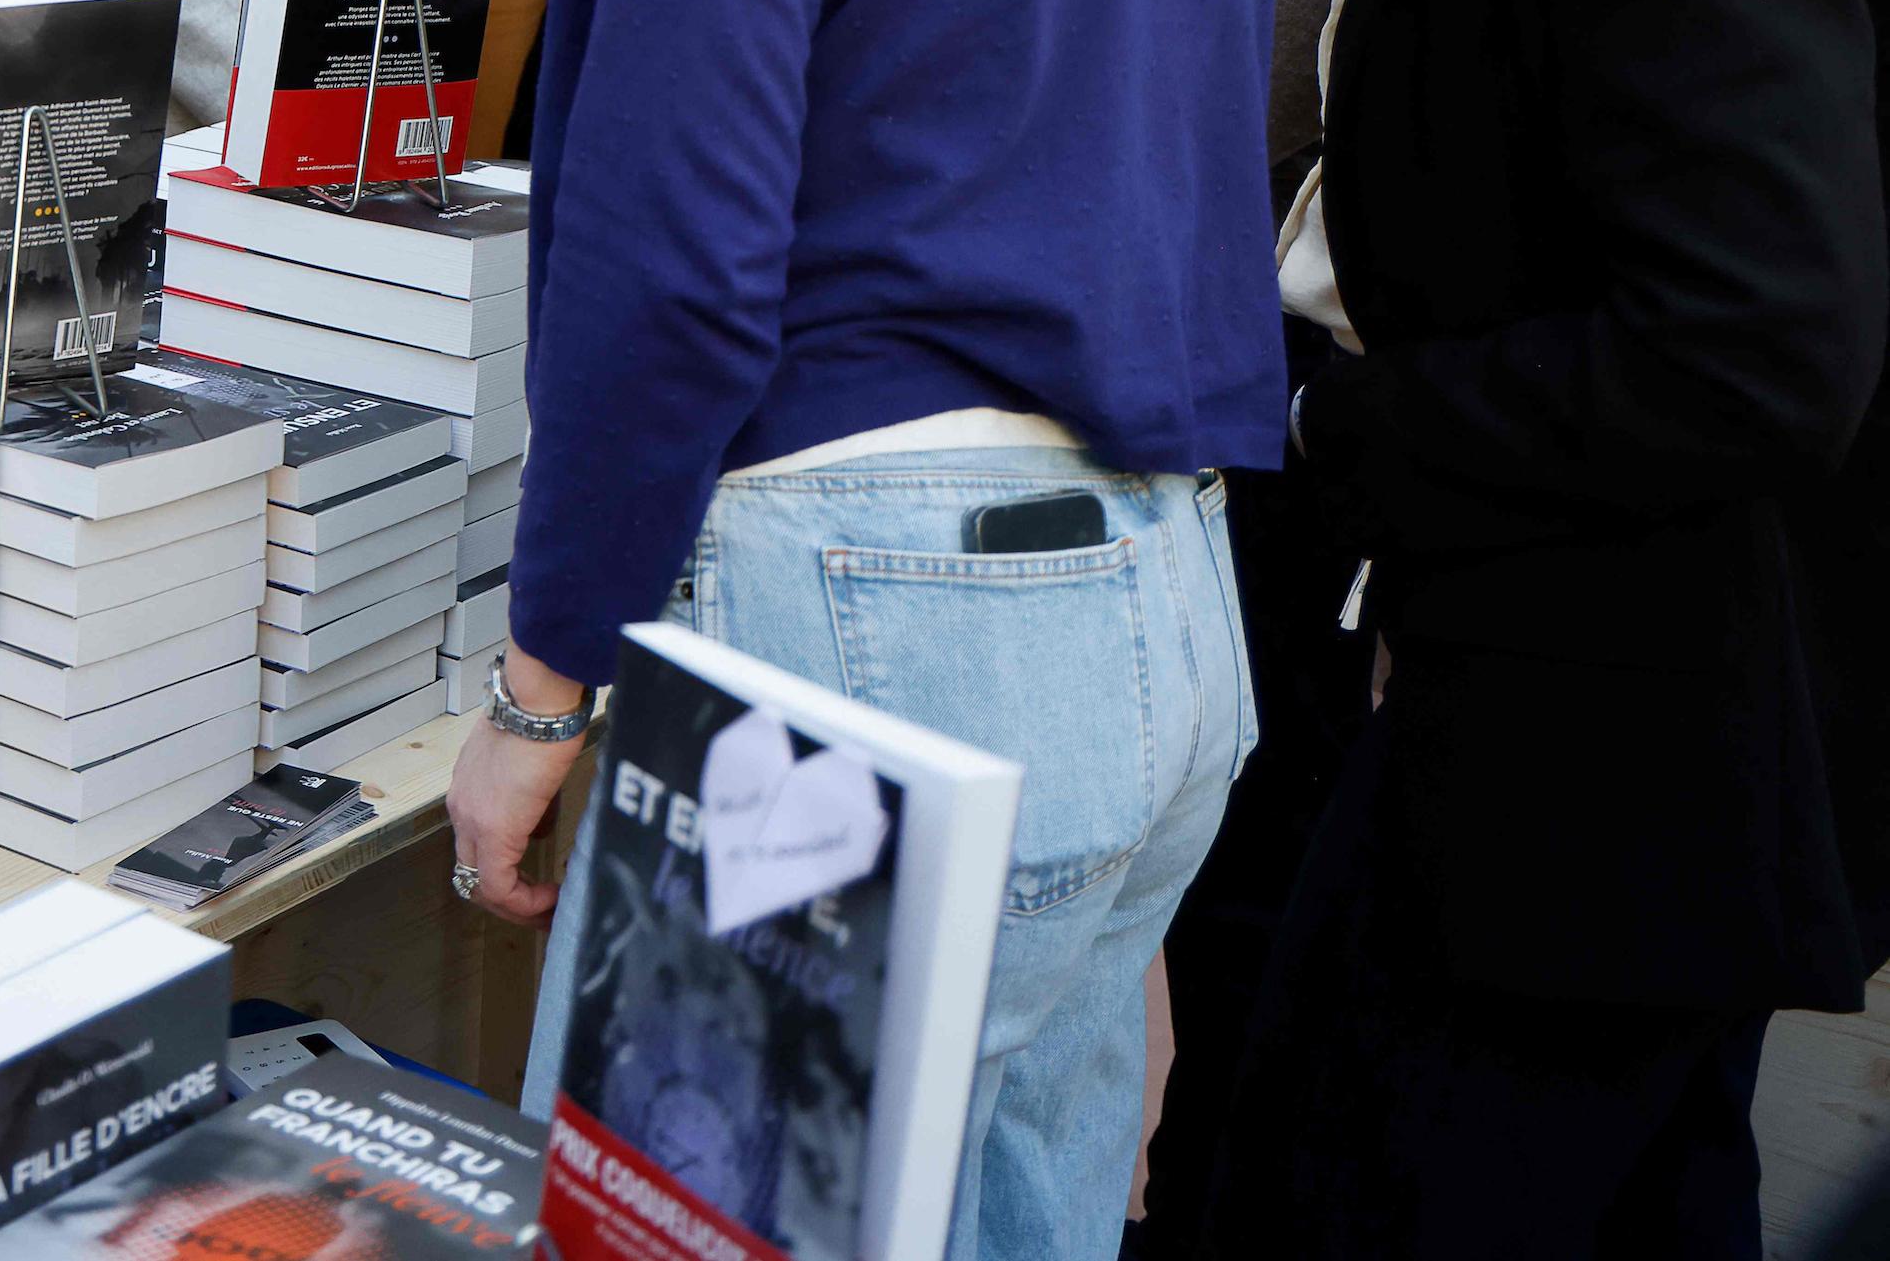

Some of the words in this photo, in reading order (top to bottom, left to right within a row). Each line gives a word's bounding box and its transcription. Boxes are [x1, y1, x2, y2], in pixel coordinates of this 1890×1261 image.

[343, 399, 382, 412] ET
[227, 805, 251, 815] QUE
[252, 811, 287, 824] RESTE
[614, 761, 665, 825] ET
[11, 1127, 93, 1196] FILLE
[96, 1062, 219, 1151] D'ENCRE
[247, 1104, 515, 1216] FRANCHIRAS
[283, 1088, 437, 1155] QUAND
[438, 1141, 505, 1176] TU
